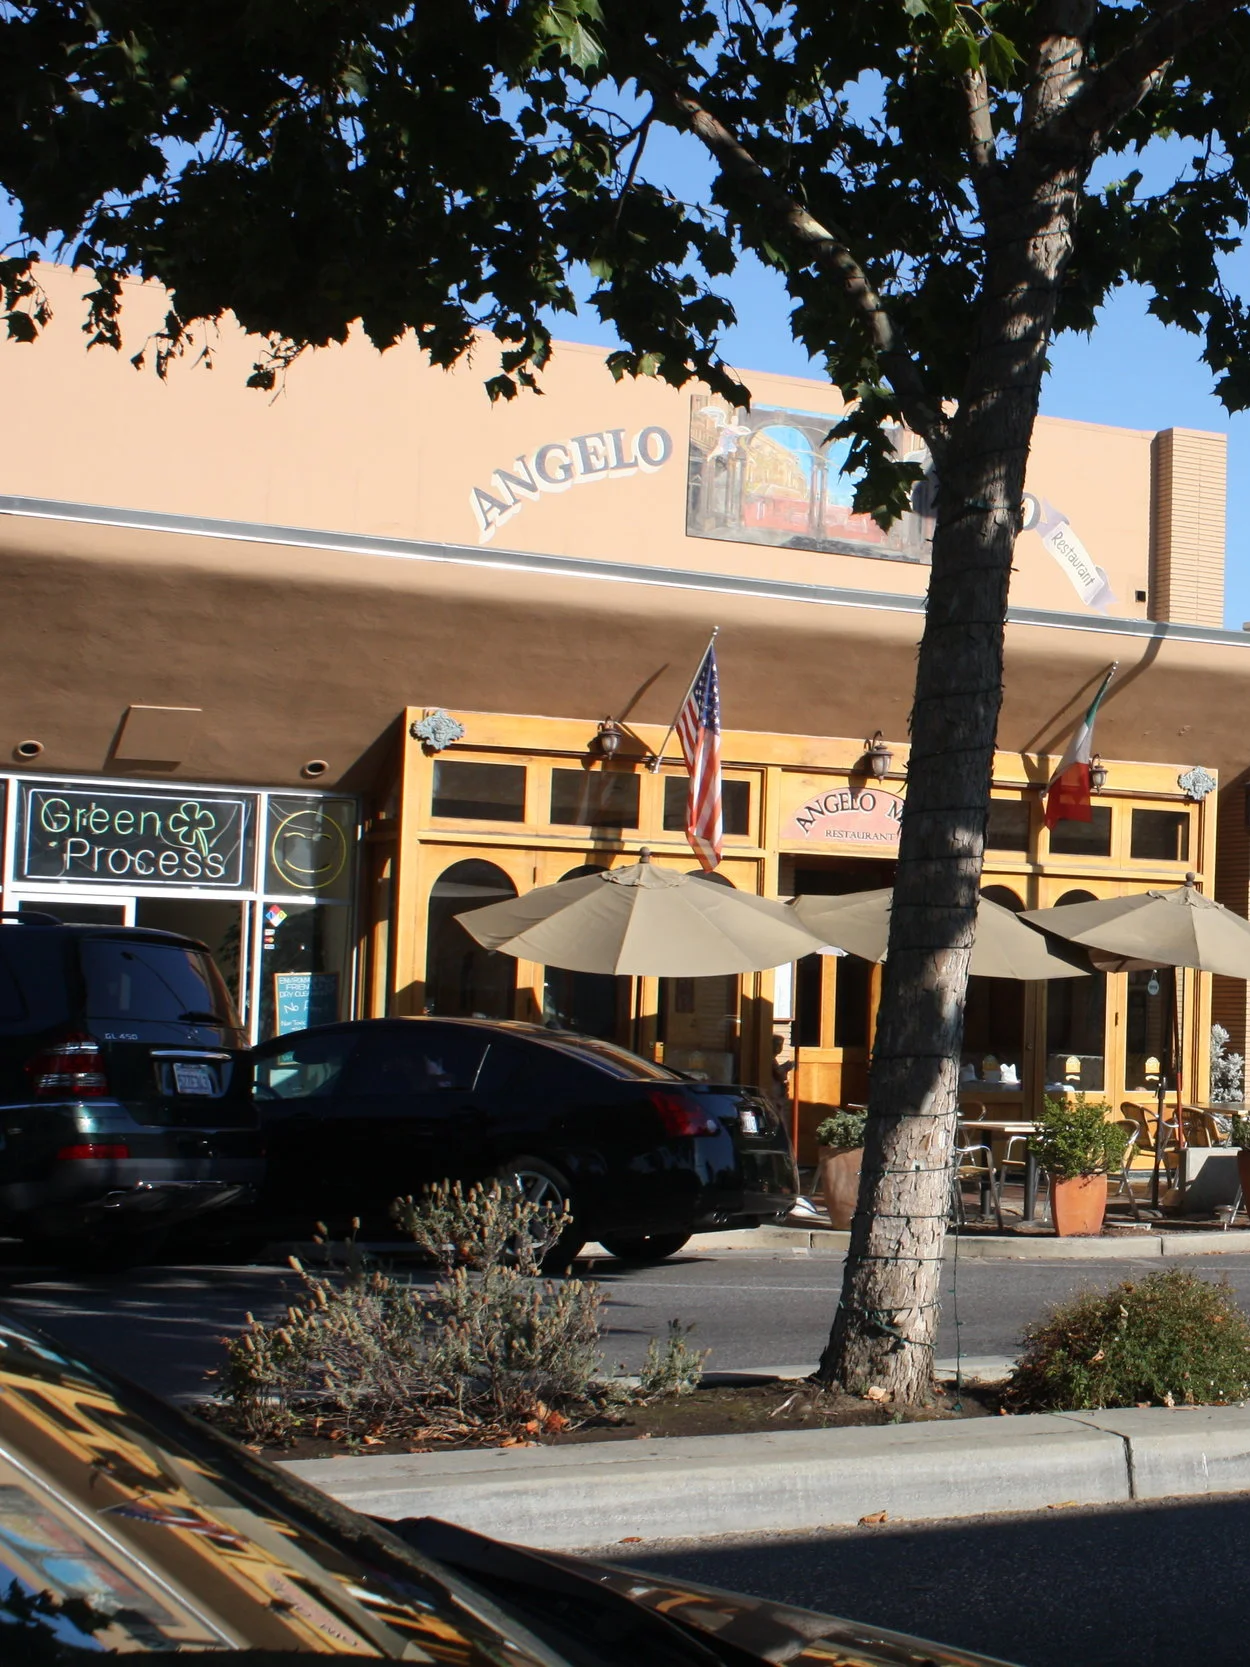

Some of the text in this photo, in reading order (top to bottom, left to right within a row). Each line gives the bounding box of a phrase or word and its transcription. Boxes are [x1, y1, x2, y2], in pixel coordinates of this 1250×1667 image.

[470, 426, 673, 538] ANGELO
[1051, 531, 1096, 587] Restaurant
[41, 798, 159, 837] Green
[795, 792, 876, 833] ANGELO
[825, 829, 896, 841] RESTAURANT
[67, 838, 224, 878] Process
